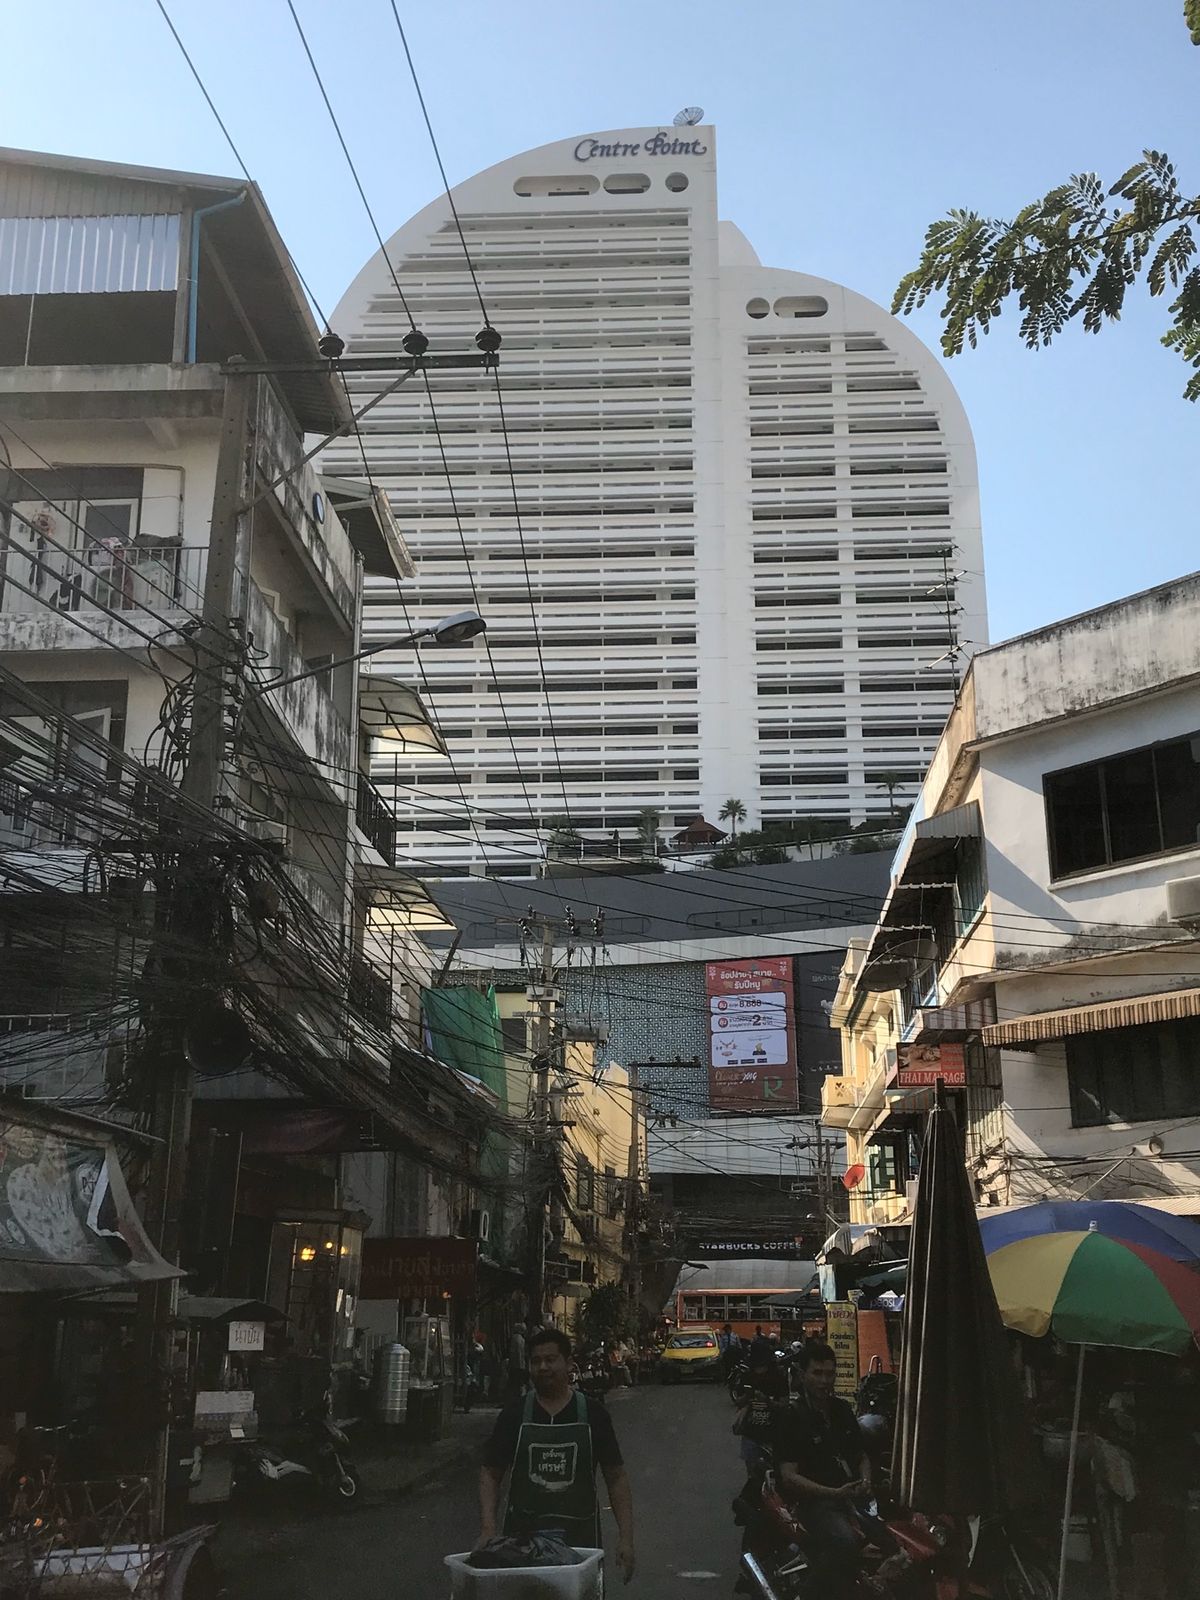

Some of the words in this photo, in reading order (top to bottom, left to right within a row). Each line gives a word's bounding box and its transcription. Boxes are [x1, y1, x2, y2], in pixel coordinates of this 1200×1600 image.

[574, 138, 640, 162] Centre
[644, 131, 707, 156] Point
[752, 1014, 761, 1026] 2
[900, 1073, 921, 1083] THAI
[699, 1242, 761, 1250] STARBUCKS
[762, 1242, 801, 1250] COFFEE
